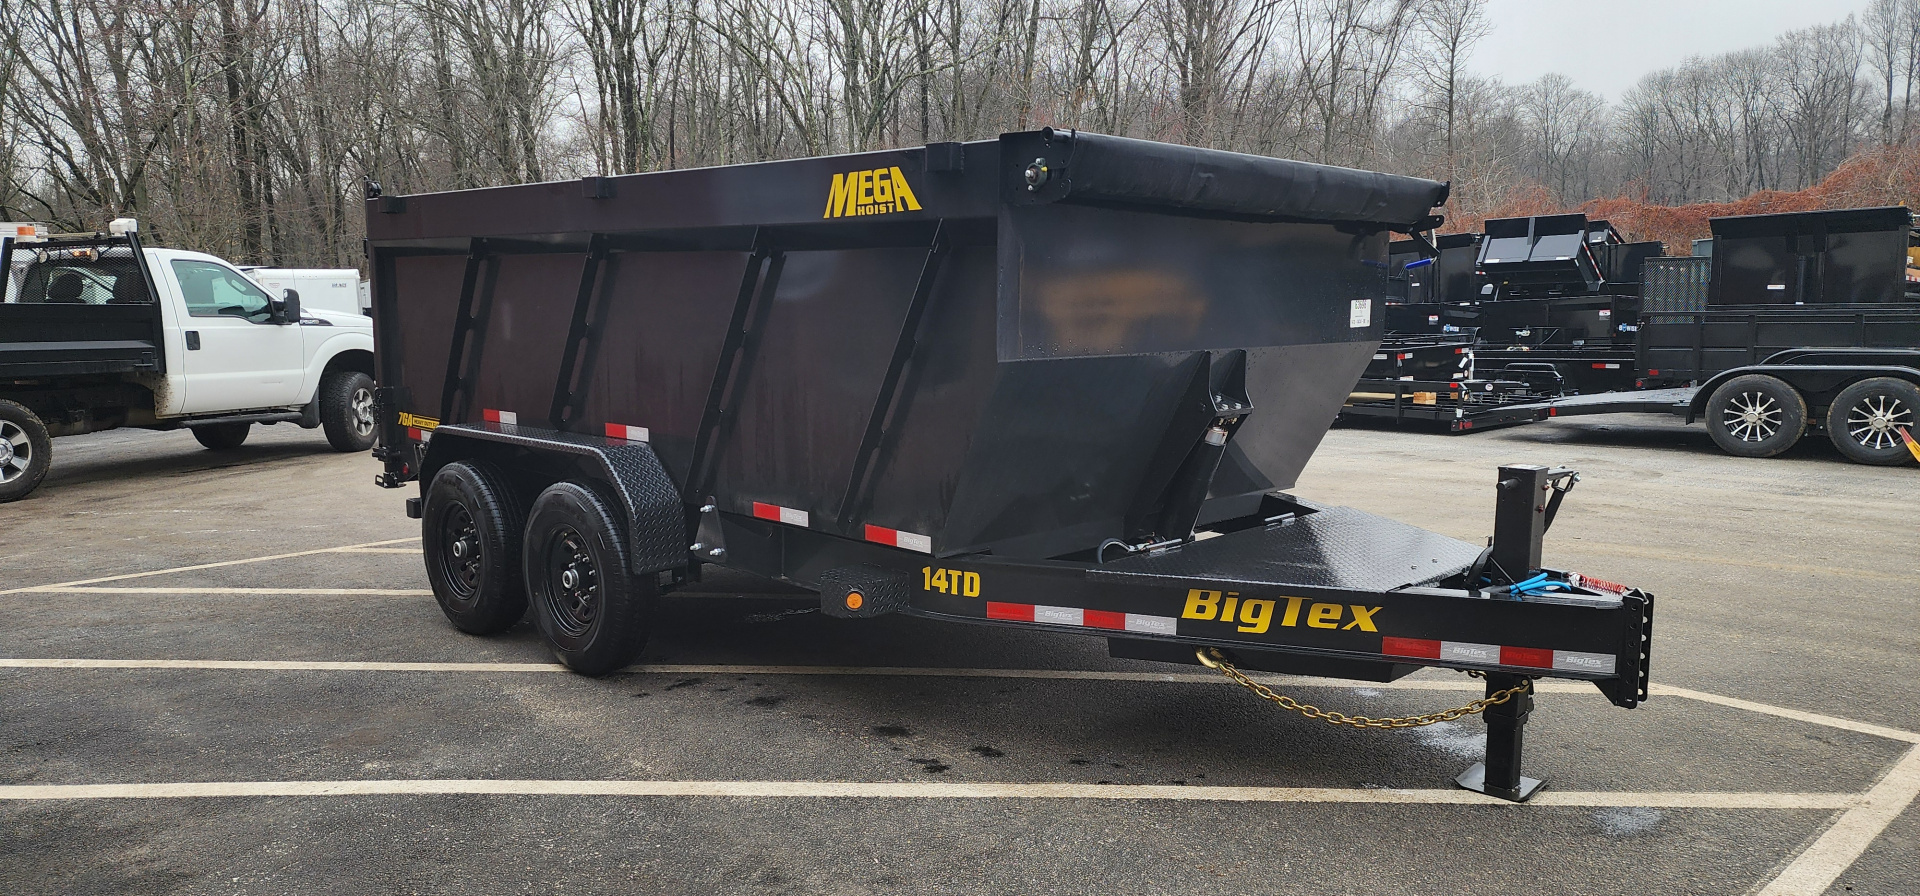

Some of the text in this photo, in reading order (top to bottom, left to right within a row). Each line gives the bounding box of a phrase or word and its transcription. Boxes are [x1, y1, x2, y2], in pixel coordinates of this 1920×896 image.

[823, 166, 923, 219] MEGA
[857, 203, 895, 216] HOIST
[397, 411, 413, 427] 7GA
[922, 566, 981, 598] 14TD
[1044, 610, 1073, 619] BigTex
[1181, 588, 1383, 634] BigTex
[1136, 619, 1166, 628] BigTex
[1452, 647, 1488, 656] BigTex
[1566, 656, 1602, 665] BigTex
